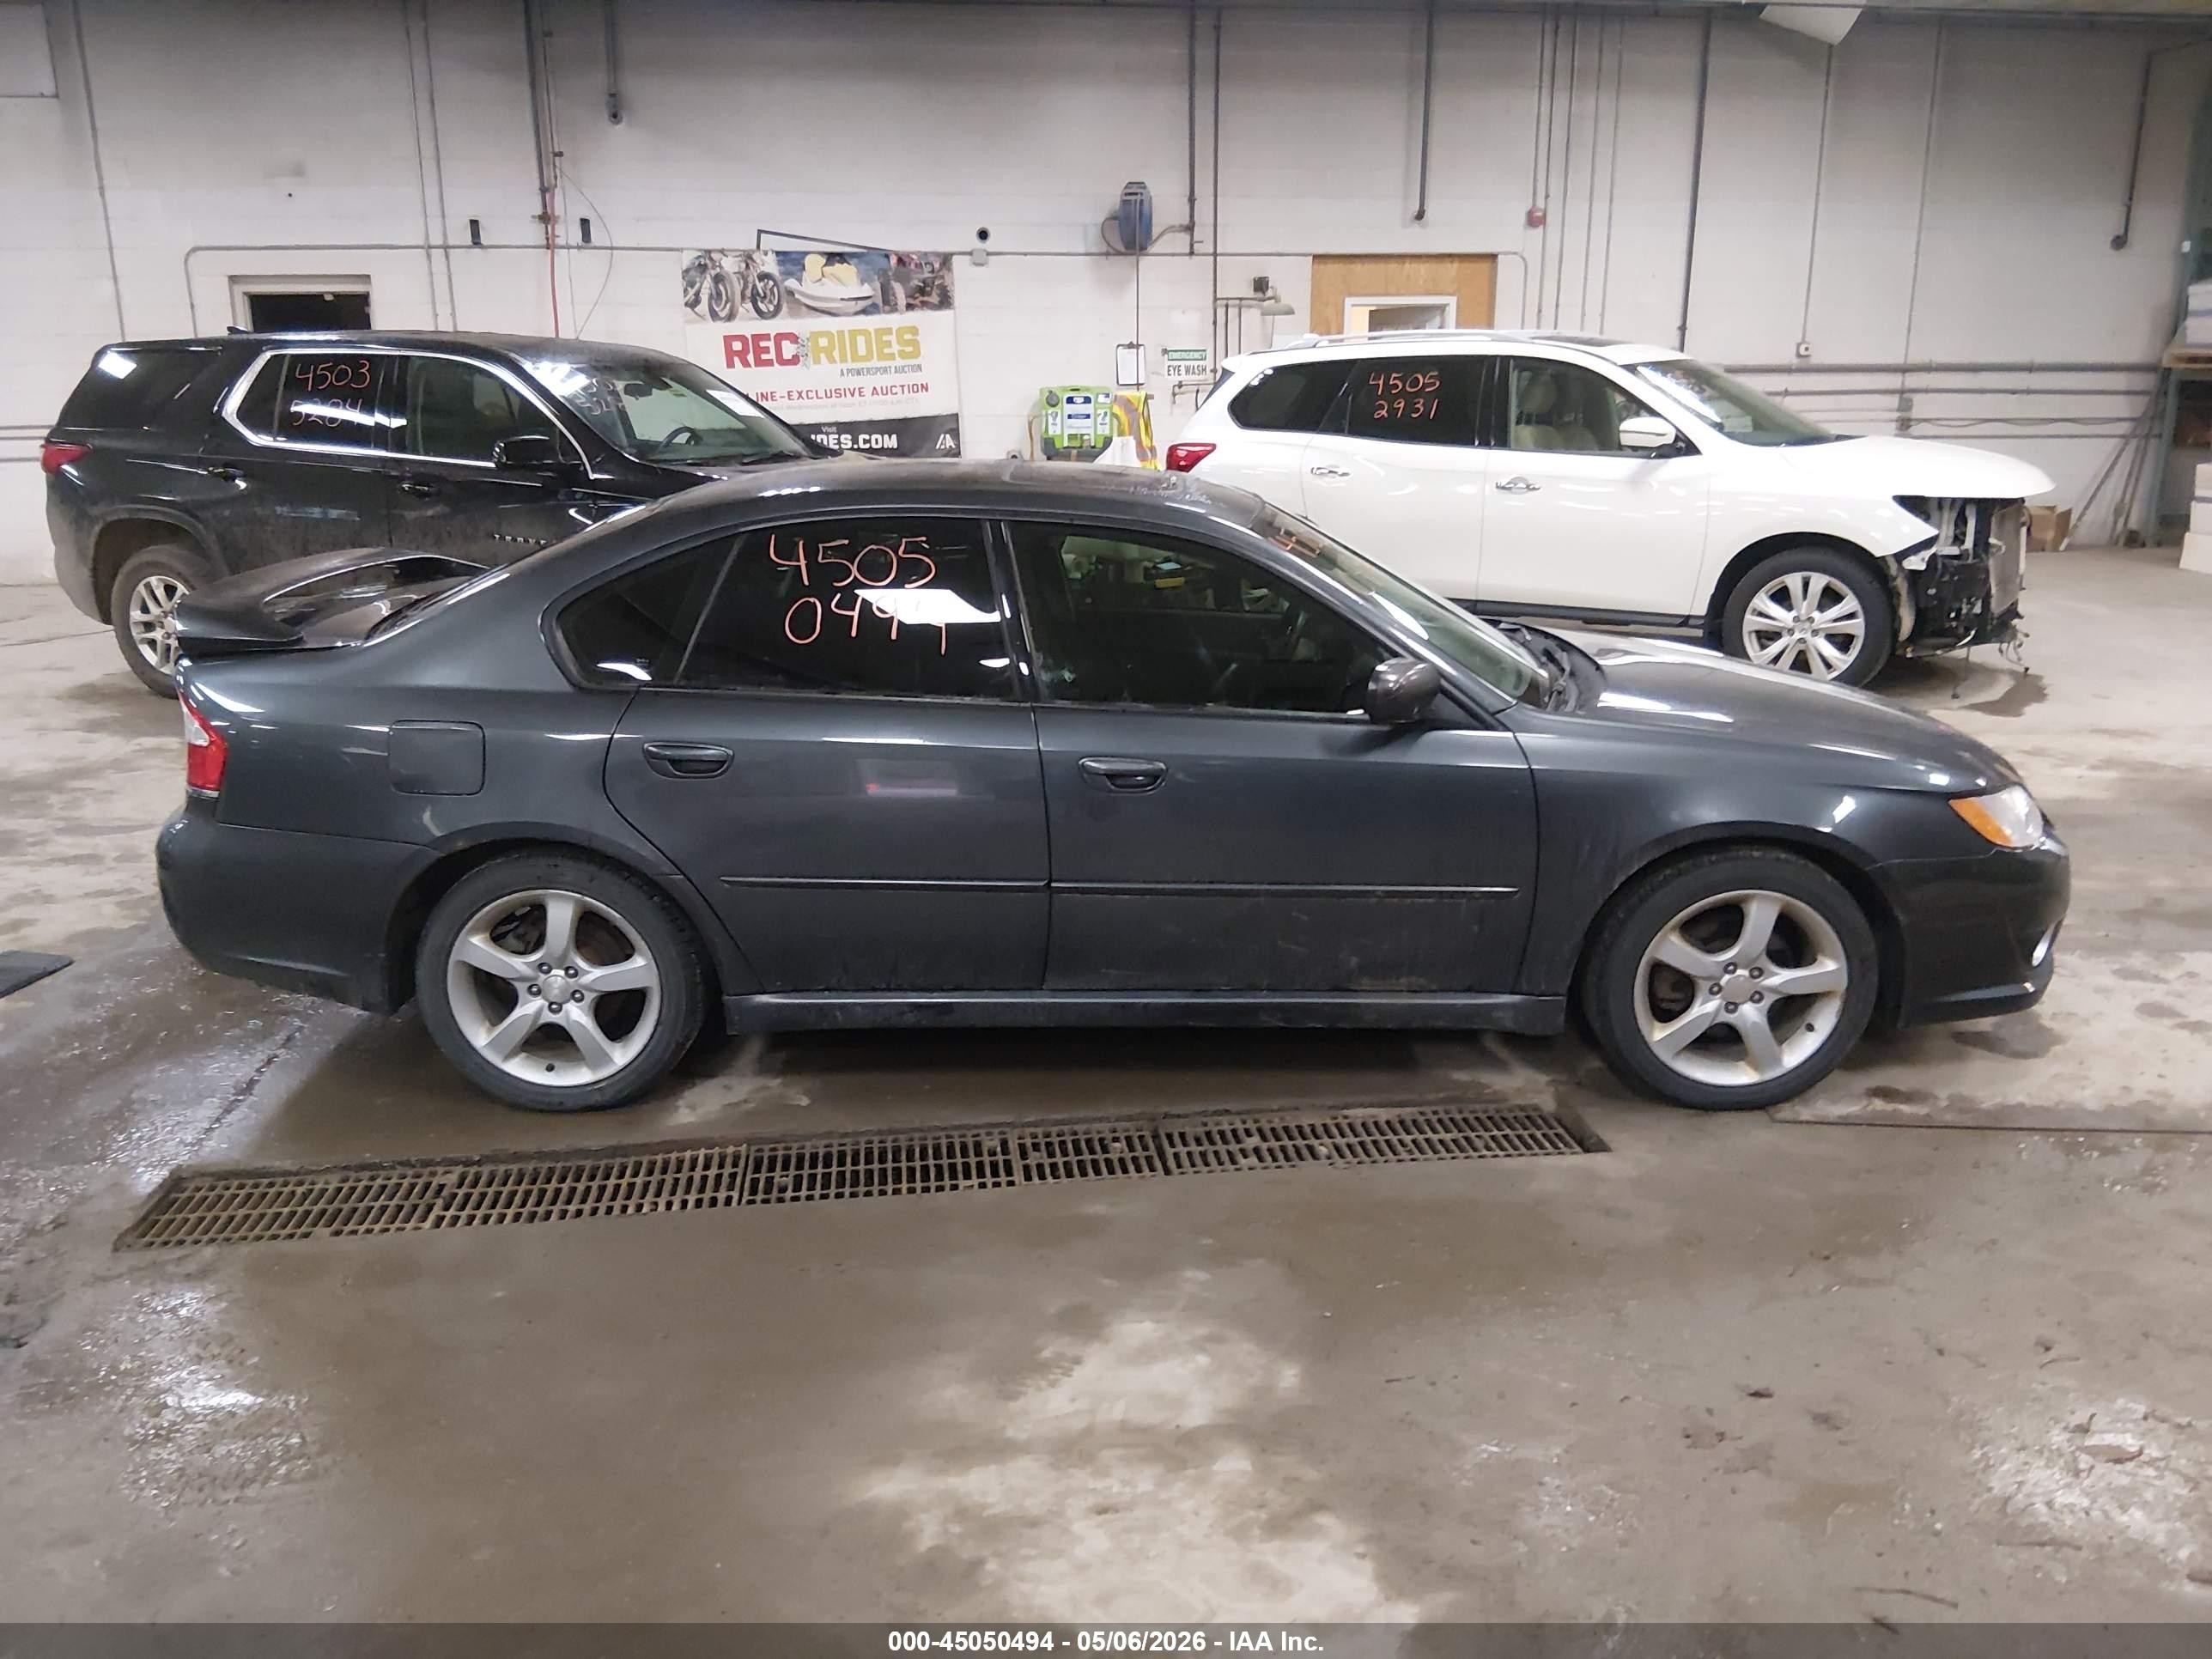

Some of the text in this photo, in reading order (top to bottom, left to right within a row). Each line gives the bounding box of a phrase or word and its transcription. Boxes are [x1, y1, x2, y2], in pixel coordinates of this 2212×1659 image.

[723, 325, 921, 369] REC RIDES
[295, 360, 371, 392] 4503
[840, 363, 922, 378] A POWERSPORT AUCTION
[1167, 364, 1207, 376] EYE WASH
[872, 382, 929, 397] AUCTION
[1369, 371, 1441, 395] 4505
[1374, 398, 1439, 419] 2931
[770, 534, 937, 589] 4505
